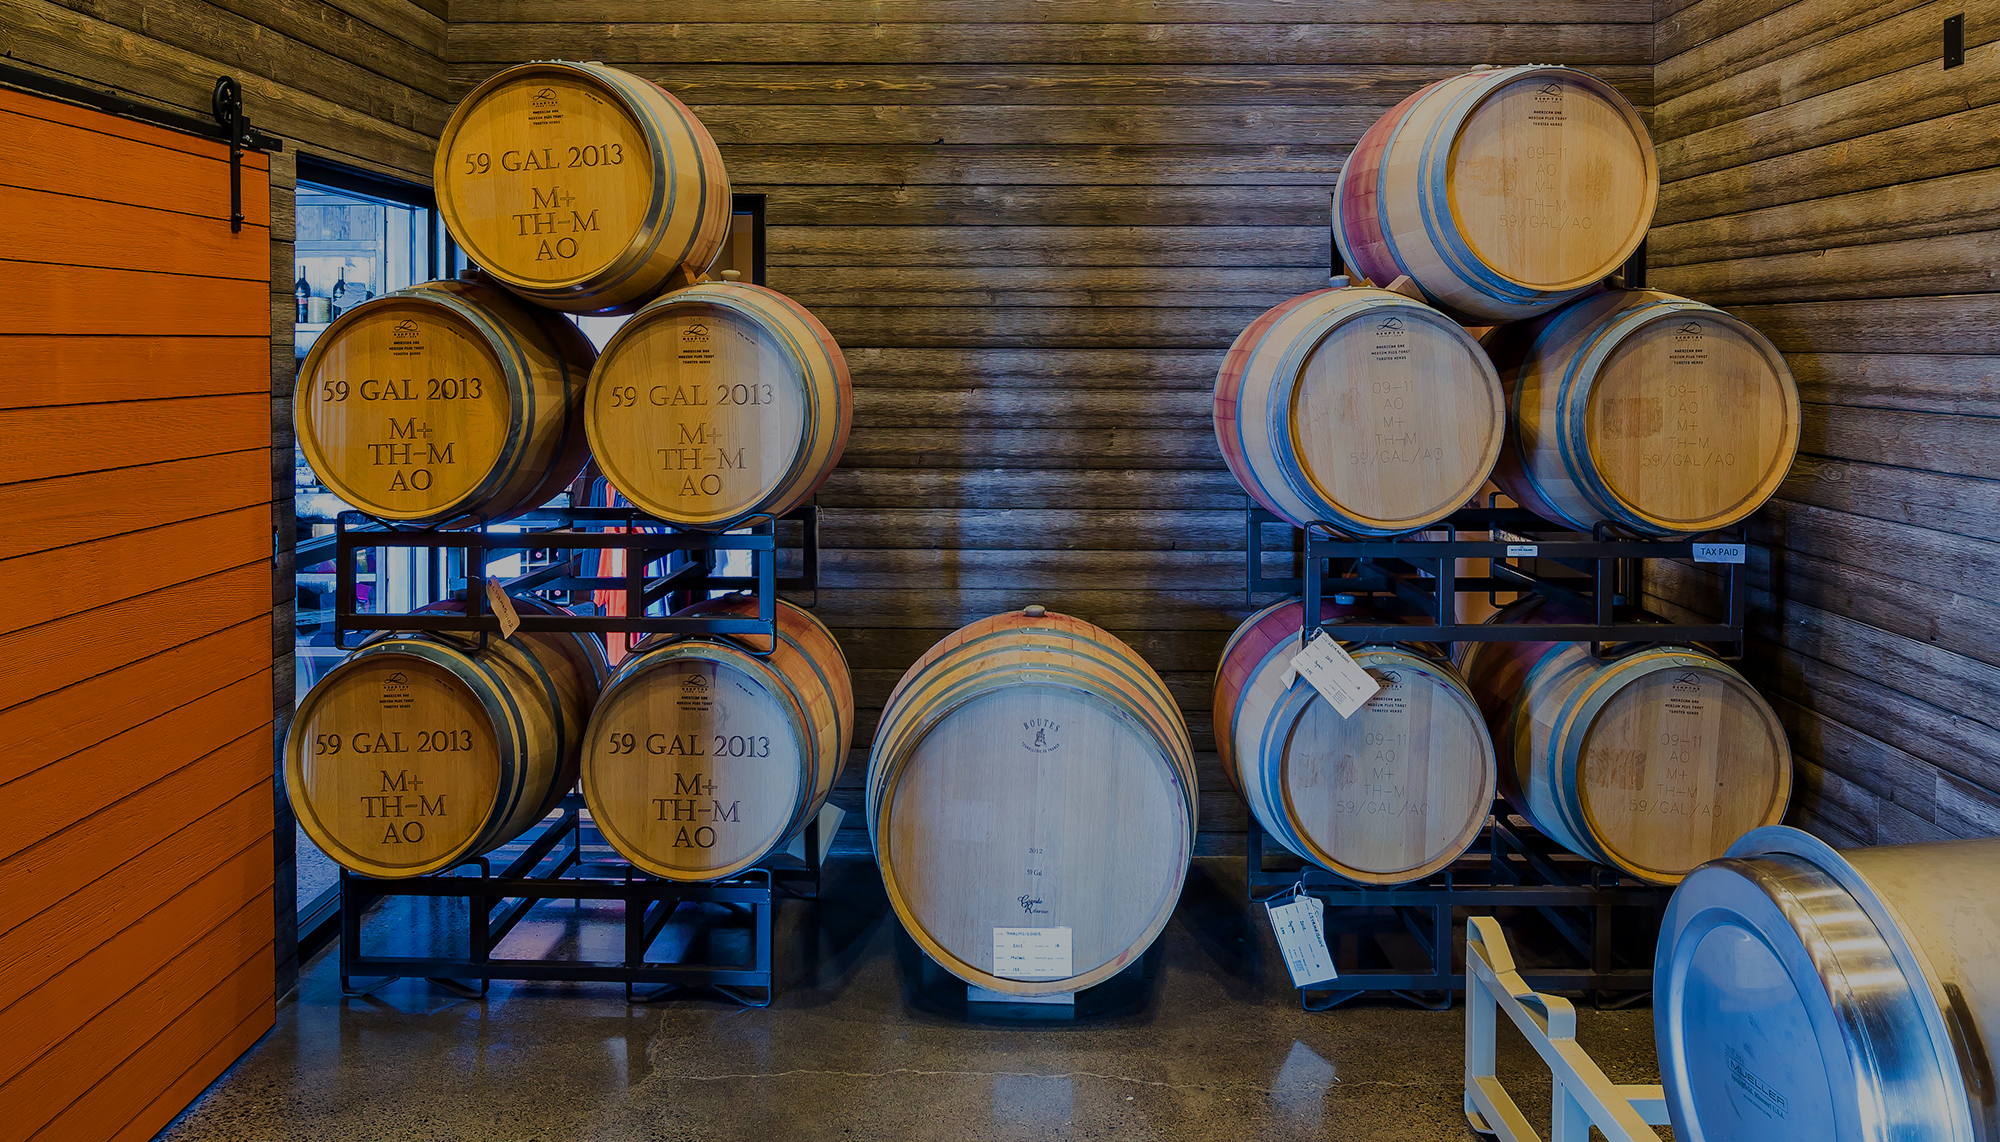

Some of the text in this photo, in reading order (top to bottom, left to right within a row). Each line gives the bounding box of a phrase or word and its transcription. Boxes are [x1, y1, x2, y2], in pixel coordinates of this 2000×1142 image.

[465, 143, 624, 175] 59 GAL 2013
[1526, 146, 1568, 160] 09-11
[1536, 163, 1557, 176] AO
[531, 186, 575, 210] M+
[512, 209, 600, 236] TH-M
[535, 237, 579, 261] AO
[324, 378, 483, 401] 59 GAL 2013
[611, 383, 774, 407] 59 GAL 2013
[1372, 380, 1414, 394] 09-11
[1668, 385, 1709, 397] 09-11
[1383, 398, 1404, 410] AO
[1678, 402, 1699, 414] AO
[389, 417, 433, 440] M+
[678, 422, 722, 445] M+
[368, 442, 455, 466] TH-M
[657, 447, 746, 470] TH-M
[389, 469, 433, 492] AO
[678, 473, 723, 496] AO
[1700, 547, 1739, 556] TAX PAID
[1023, 718, 1061, 733] BOUTES
[315, 730, 473, 755] 59 GAL 2013
[608, 733, 771, 758] 59 GAL 2013
[1365, 733, 1407, 747] 09-11
[1660, 733, 1702, 747] 09-11
[1375, 750, 1395, 762] AO
[1669, 751, 1690, 764] AO
[381, 770, 423, 792] M+
[673, 773, 718, 796] M+
[360, 794, 447, 818] TH-M
[652, 799, 741, 823] TH-M
[381, 821, 425, 844] AO
[672, 826, 717, 848] AO
[1028, 847, 1043, 855] 2012
[1730, 1059, 1785, 1109] MUELLER
